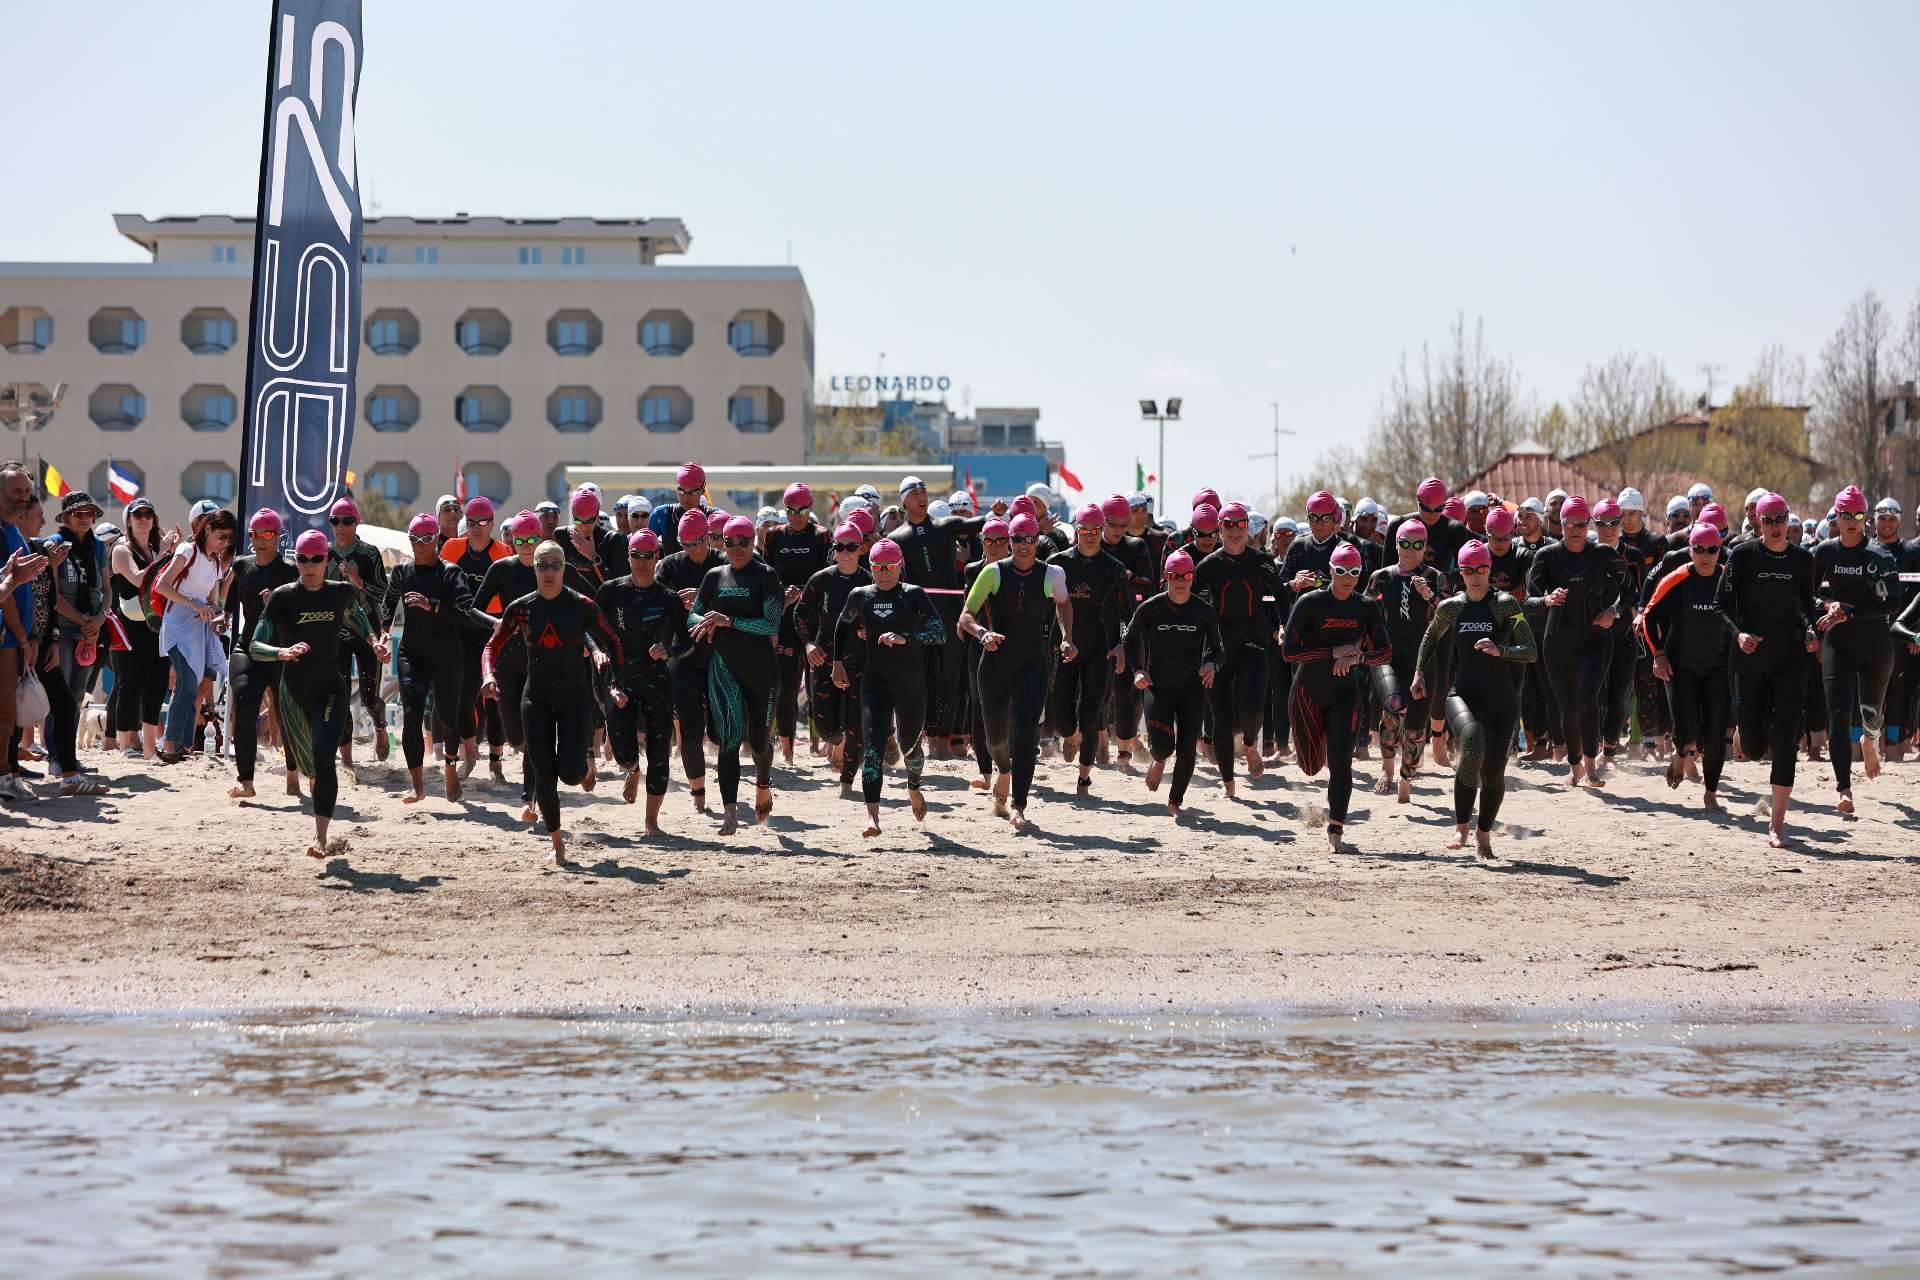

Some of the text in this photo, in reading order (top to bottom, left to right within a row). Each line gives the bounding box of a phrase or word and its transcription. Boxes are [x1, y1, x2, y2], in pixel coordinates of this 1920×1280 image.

[831, 376, 951, 391] LEONARDO
[296, 611, 335, 625] ZOGGS
[1457, 622, 1493, 634] ZOGGS
